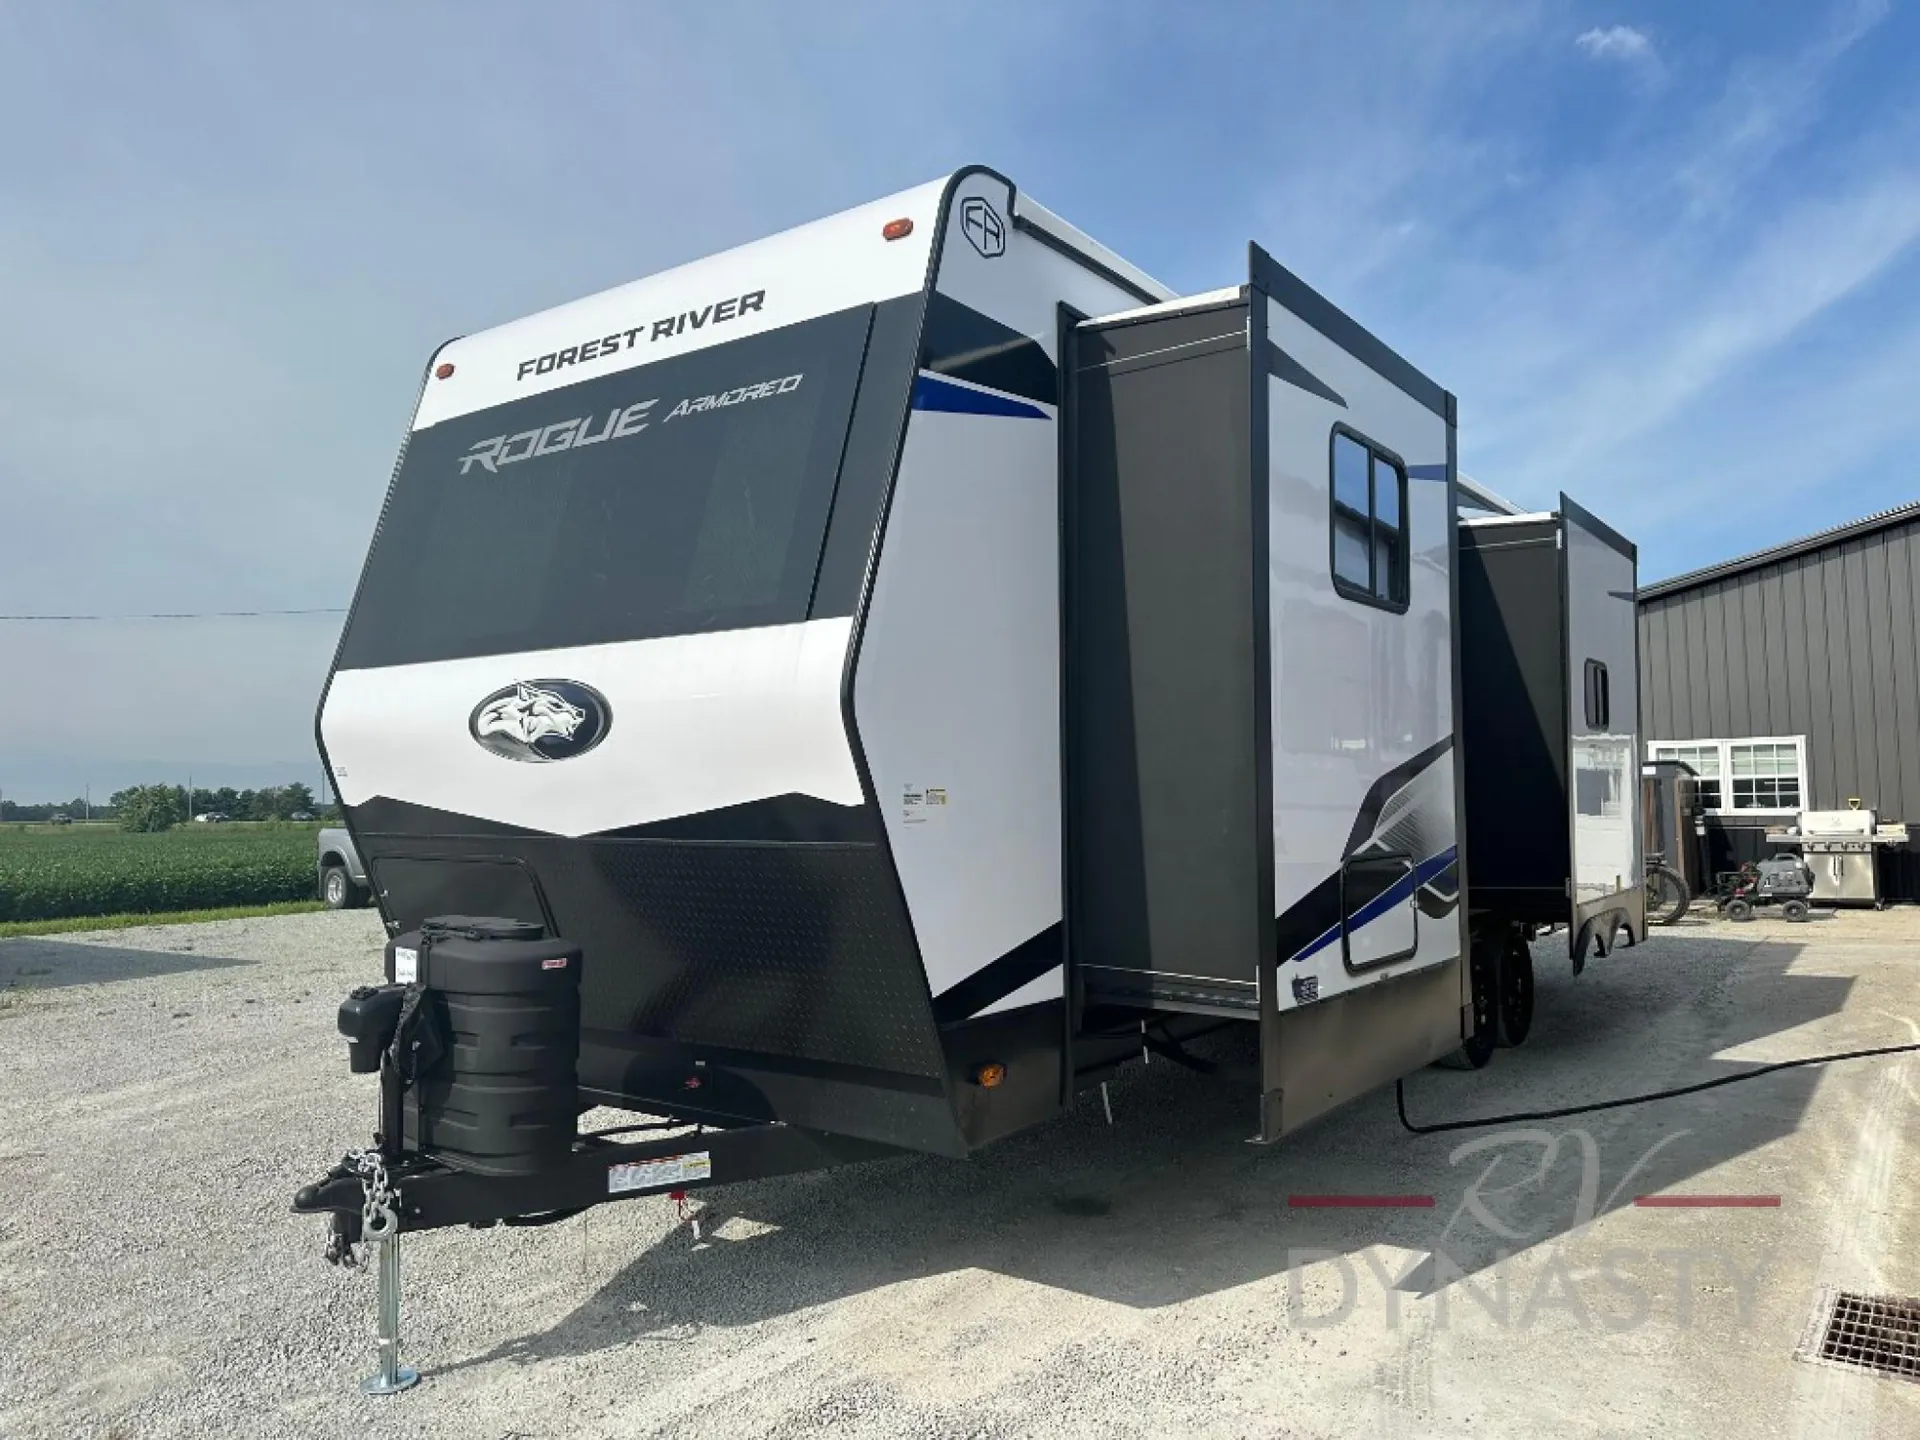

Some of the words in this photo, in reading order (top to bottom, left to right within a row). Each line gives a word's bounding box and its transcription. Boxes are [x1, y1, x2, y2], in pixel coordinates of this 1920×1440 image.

[517, 325, 645, 381] FOREST
[650, 289, 766, 342] RIVER
[457, 398, 660, 475] ROGUE
[663, 373, 804, 424] ARMORED
